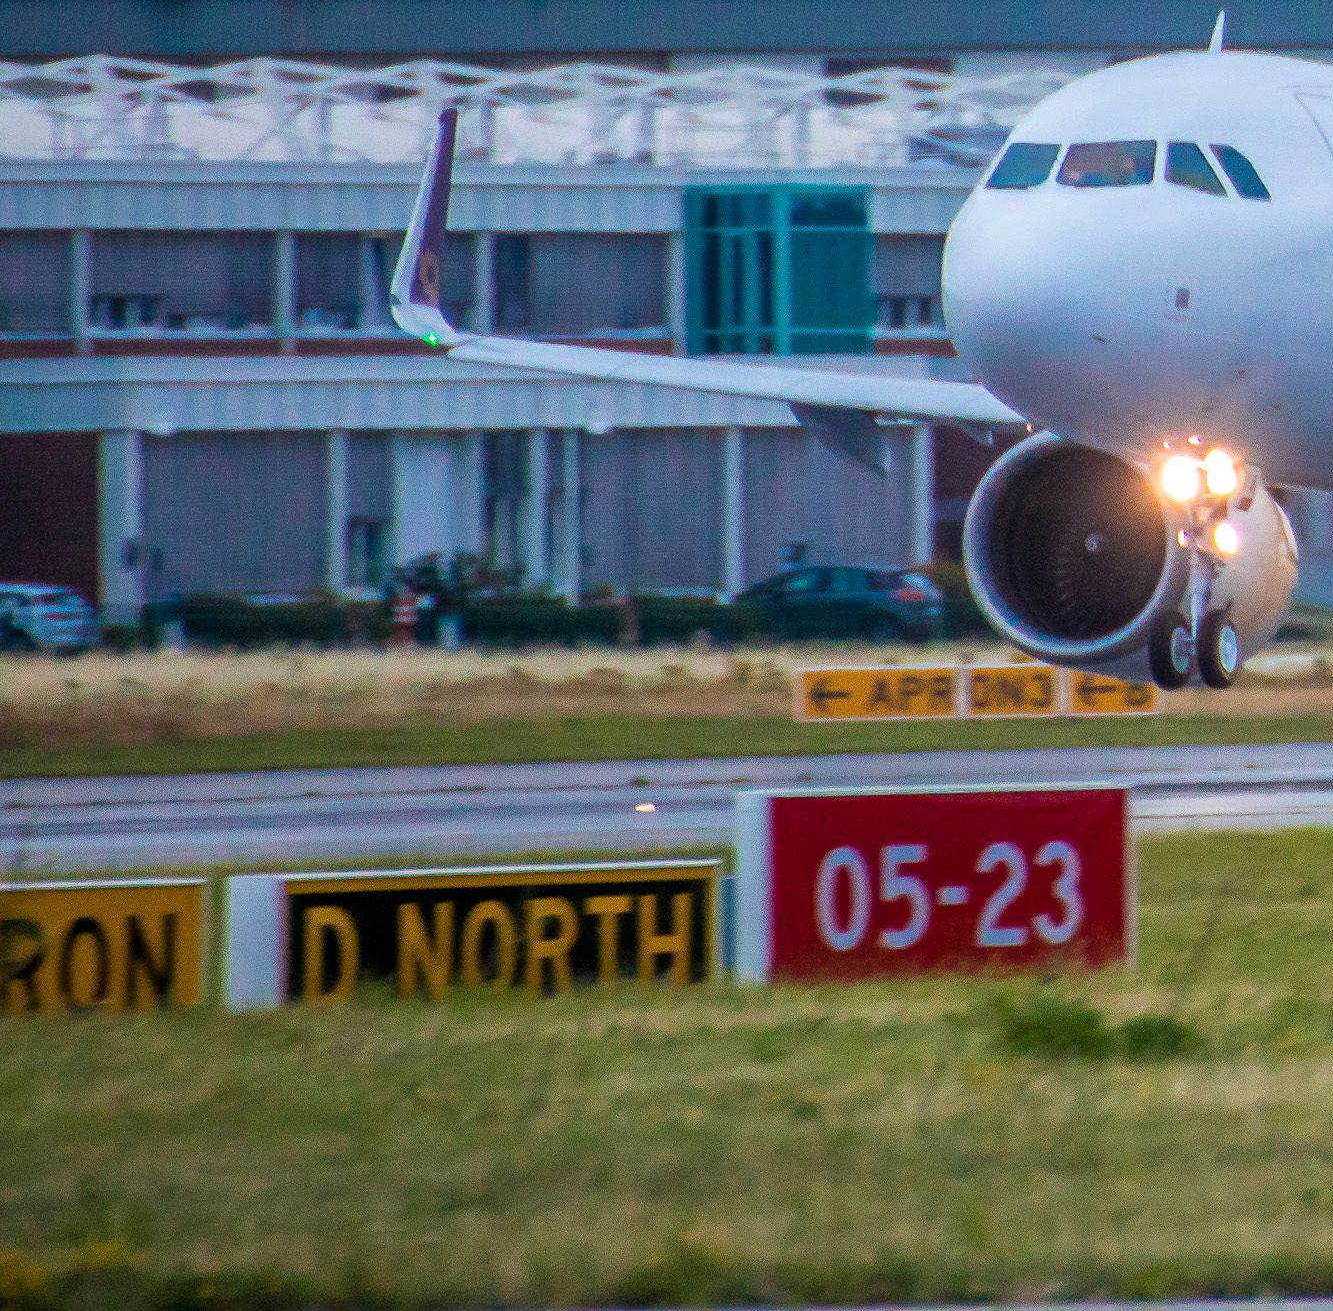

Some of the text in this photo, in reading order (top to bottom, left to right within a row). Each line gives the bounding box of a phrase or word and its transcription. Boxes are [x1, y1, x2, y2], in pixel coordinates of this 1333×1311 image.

[303, 892, 693, 1002] D NORTH
[814, 840, 1086, 951] 05-23
